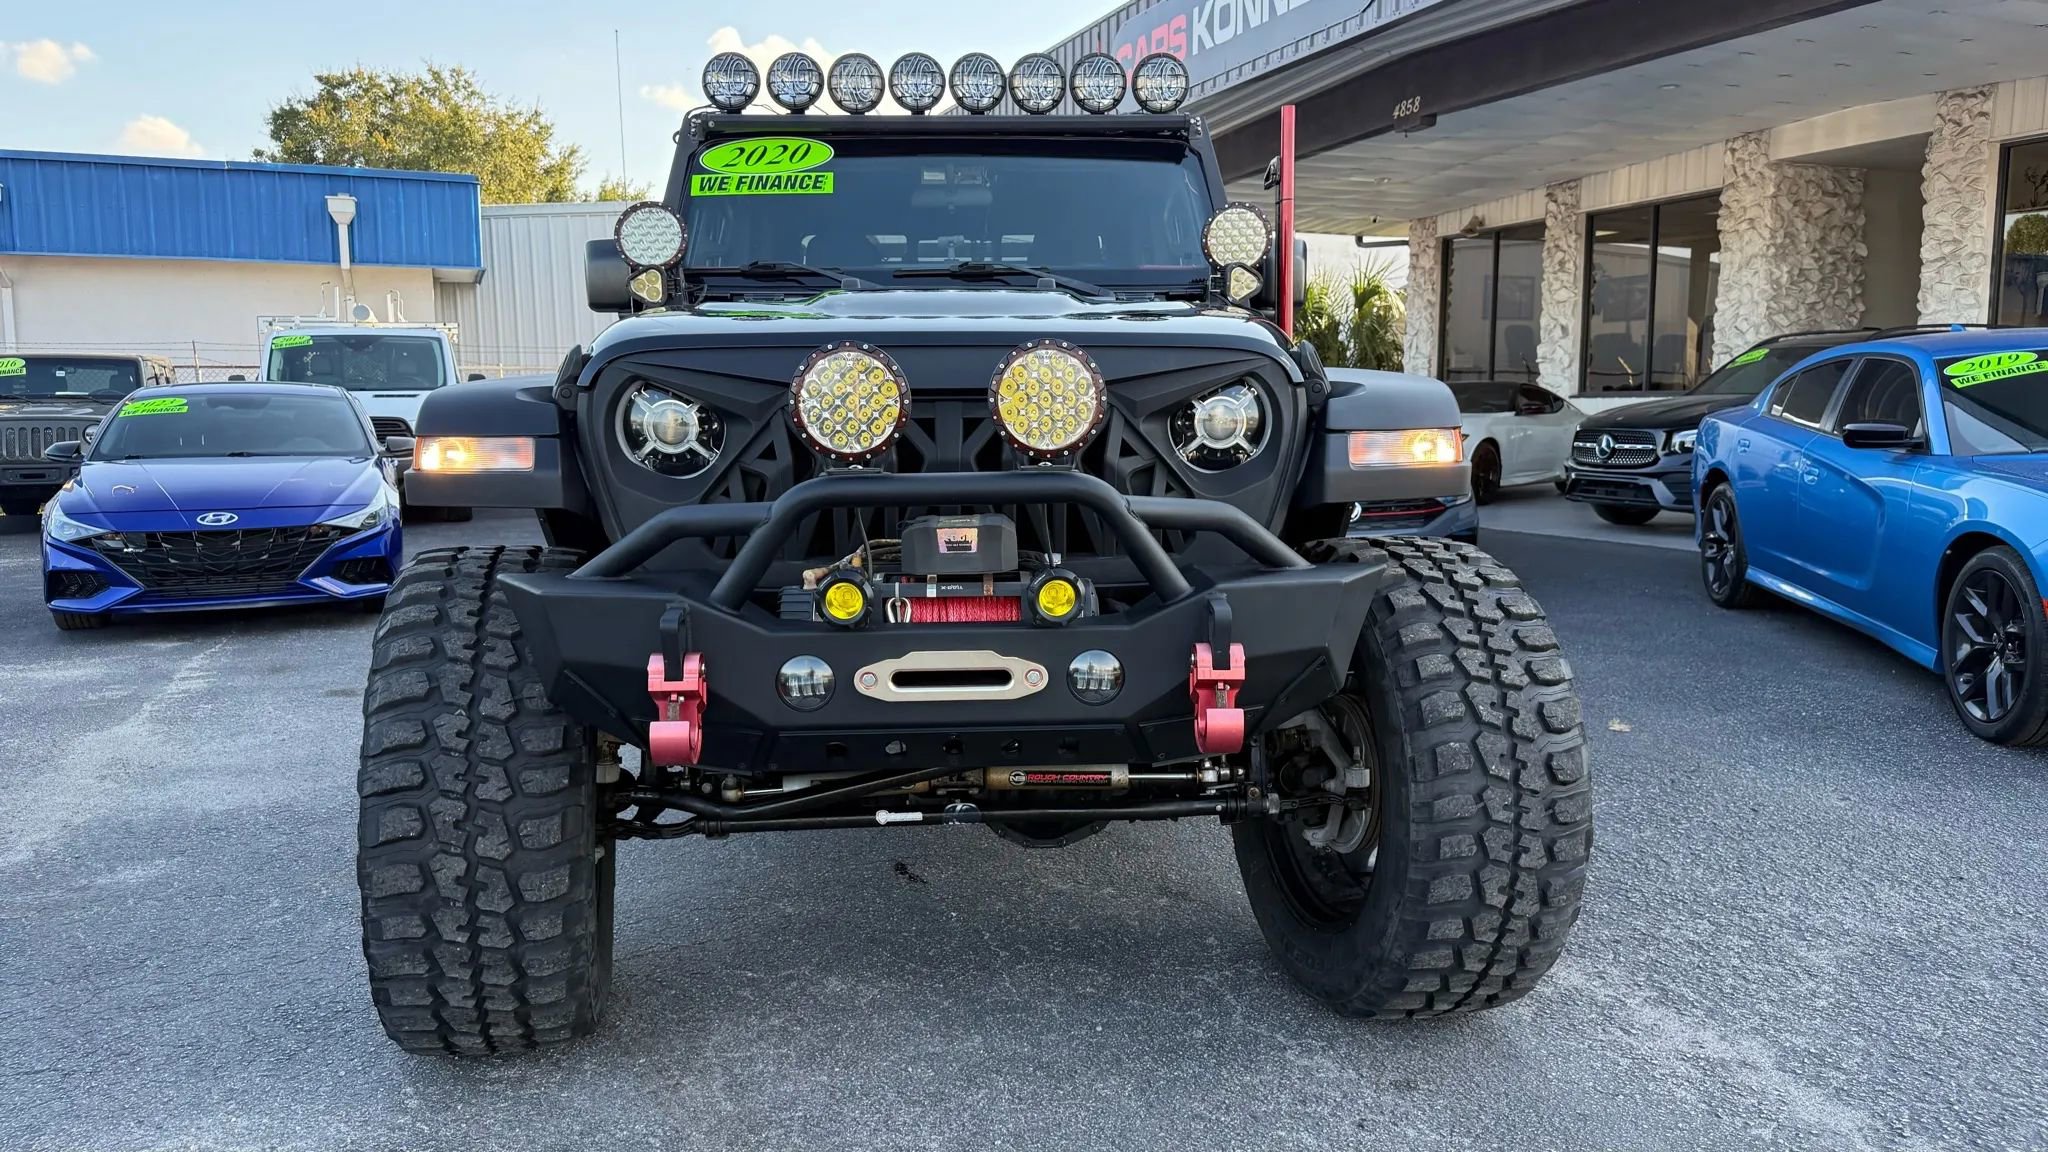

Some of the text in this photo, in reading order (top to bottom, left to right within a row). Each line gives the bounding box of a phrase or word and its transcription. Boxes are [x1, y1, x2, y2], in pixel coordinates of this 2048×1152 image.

[1192, 0, 1313, 56] KON
[1392, 95, 1420, 120] 4858
[721, 143, 812, 168] 2020
[699, 174, 828, 193] WE FINANCE
[1957, 362, 2046, 385] WE FINANCE
[1964, 353, 2020, 373] 2019
